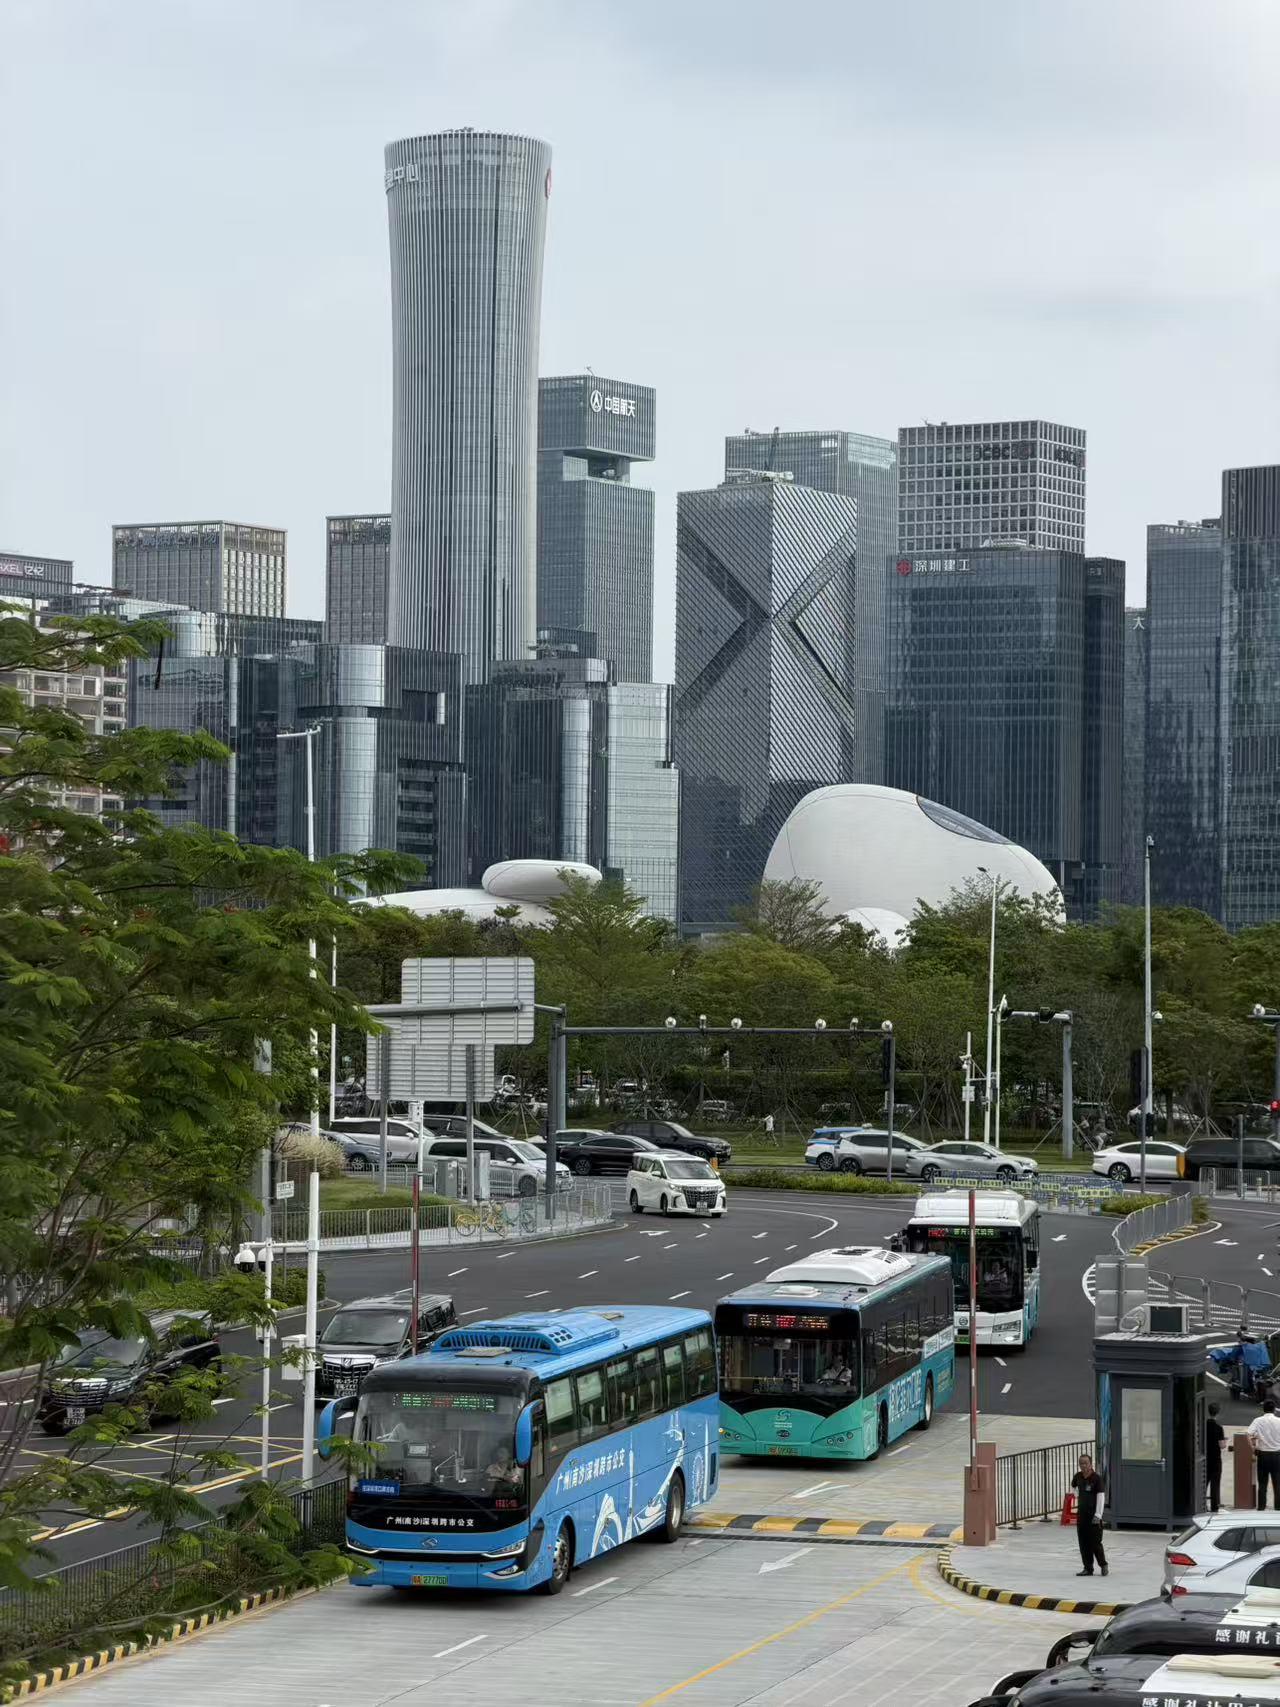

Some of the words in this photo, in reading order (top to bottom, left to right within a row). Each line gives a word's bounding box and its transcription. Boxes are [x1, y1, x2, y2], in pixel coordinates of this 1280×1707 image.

[604, 395, 636, 417] 中国航天
[913, 559, 970, 573] 深圳建工
